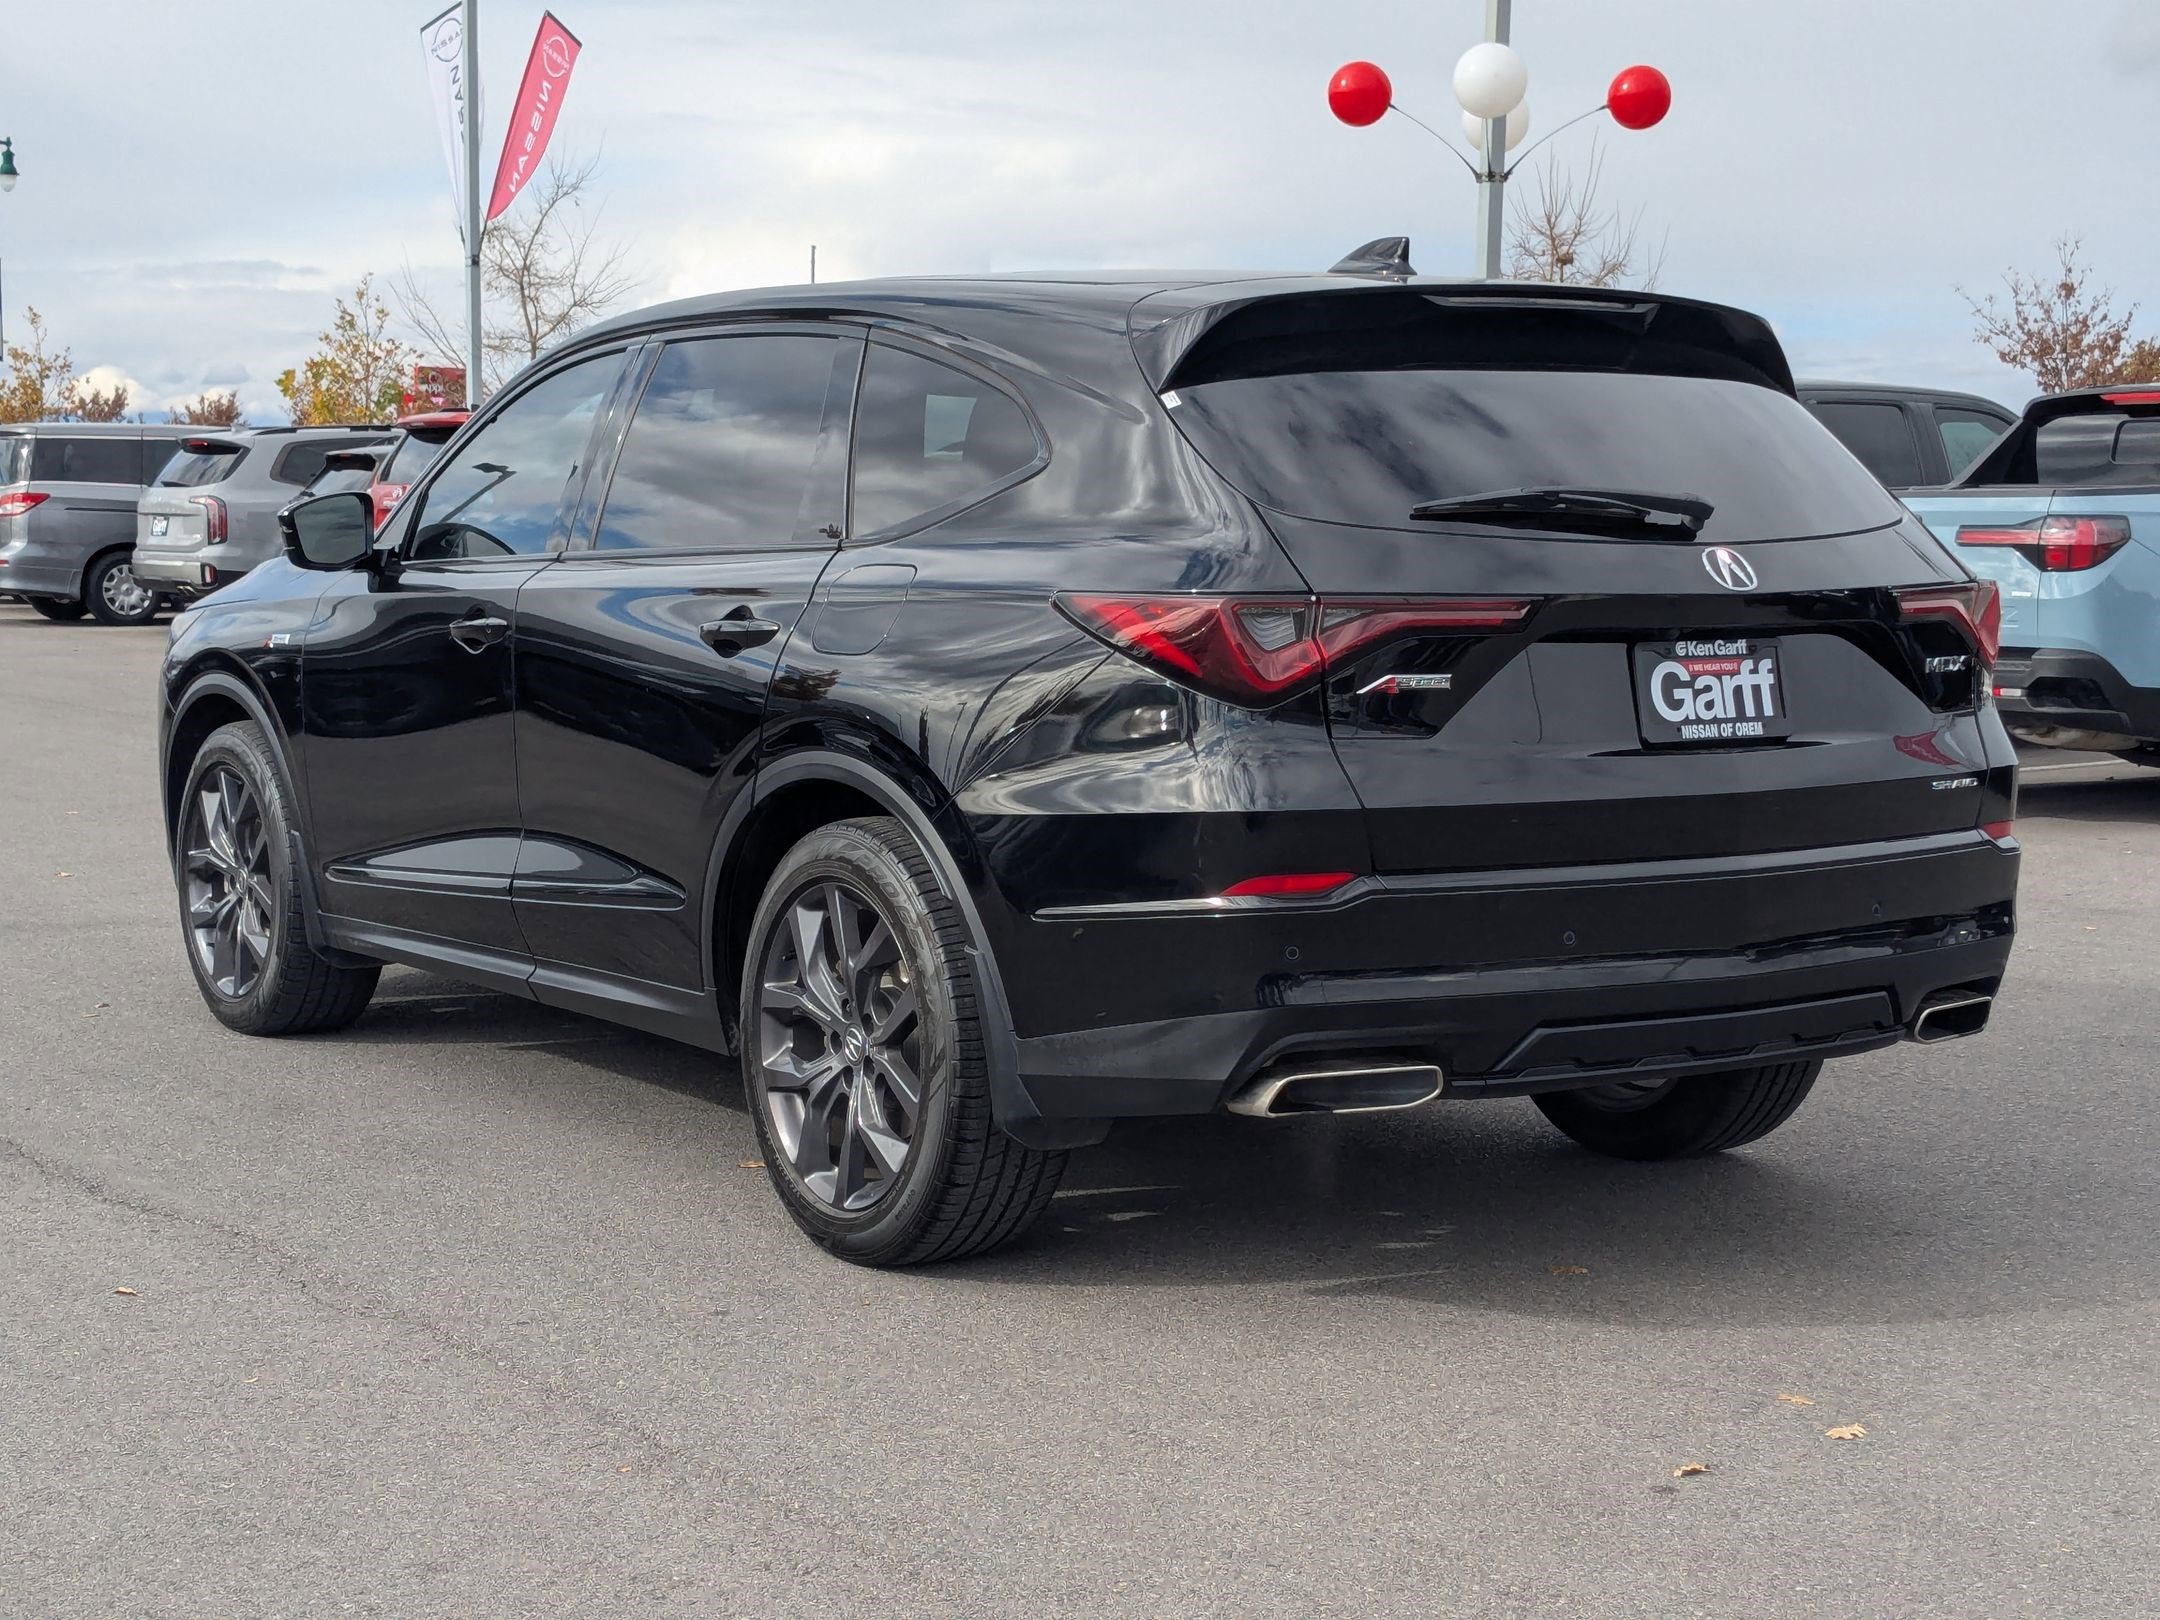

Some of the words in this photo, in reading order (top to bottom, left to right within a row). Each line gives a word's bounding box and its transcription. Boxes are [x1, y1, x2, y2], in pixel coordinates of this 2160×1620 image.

[1687, 640, 1714, 656] Ken
[1714, 639, 1747, 656] Garff
[1650, 659, 1774, 722] Garff
[1681, 723, 1719, 739] NISSAN
[1721, 722, 1735, 737] OF
[1735, 721, 1764, 736] OREM
